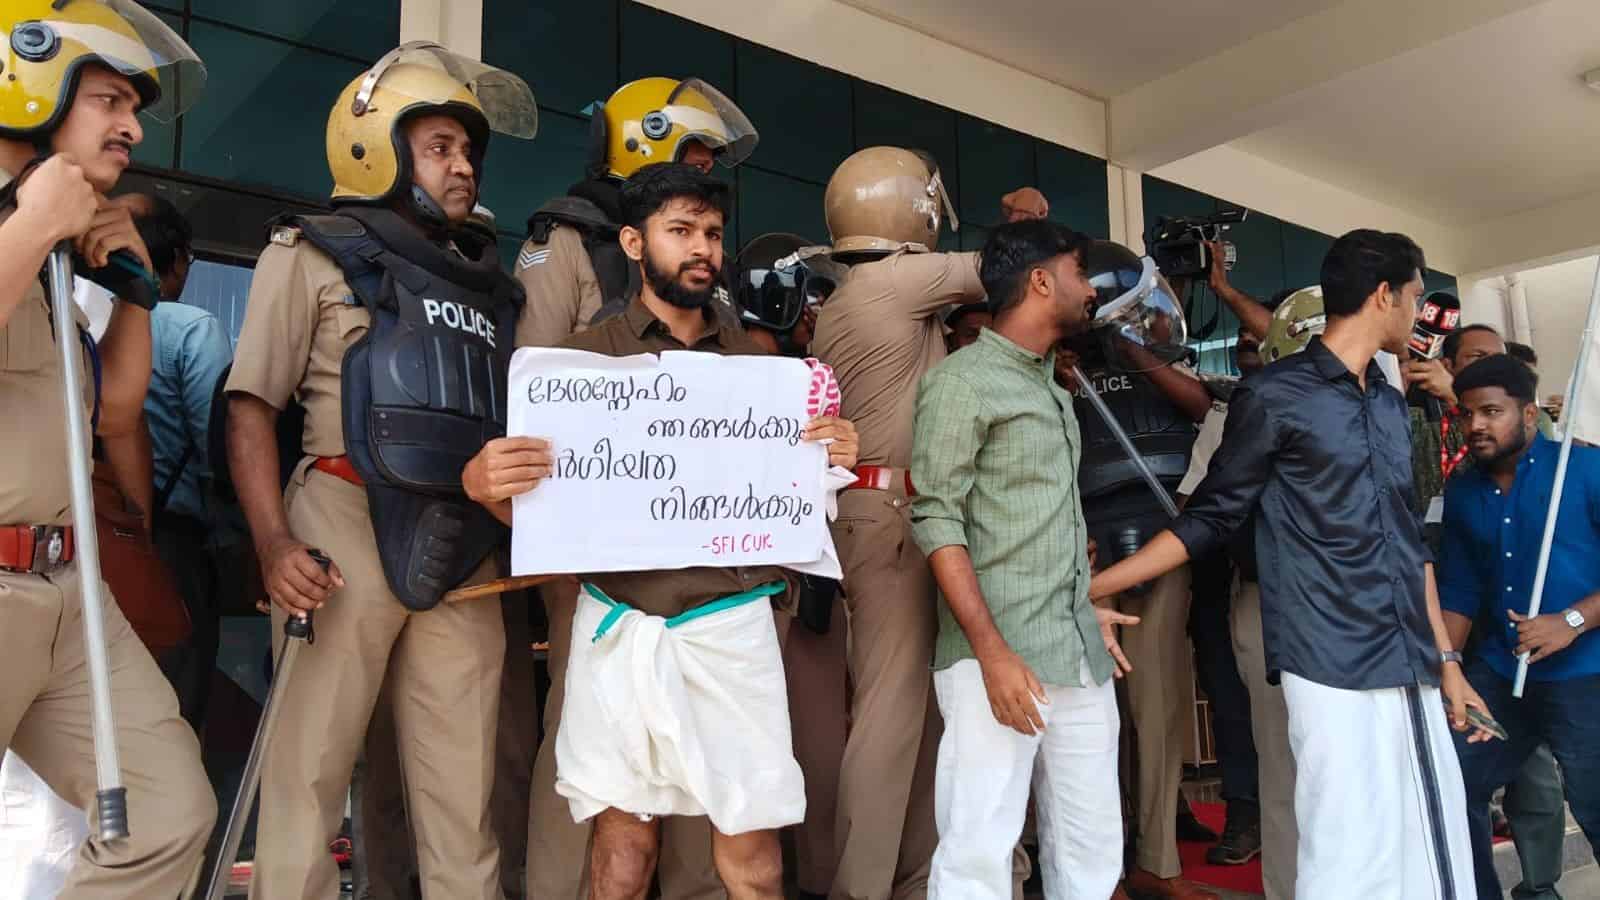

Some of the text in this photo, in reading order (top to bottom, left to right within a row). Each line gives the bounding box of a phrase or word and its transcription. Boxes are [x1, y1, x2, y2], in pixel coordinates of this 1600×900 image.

[423, 298, 497, 349] POLICE
[1445, 311, 1459, 328] 18
[528, 372, 687, 411] ദേശസ്നേഹം
[552, 437, 677, 481] ർഗീയത
[649, 482, 813, 526] നിങ്ങൾക്കും
[742, 533, 773, 553] CUK
